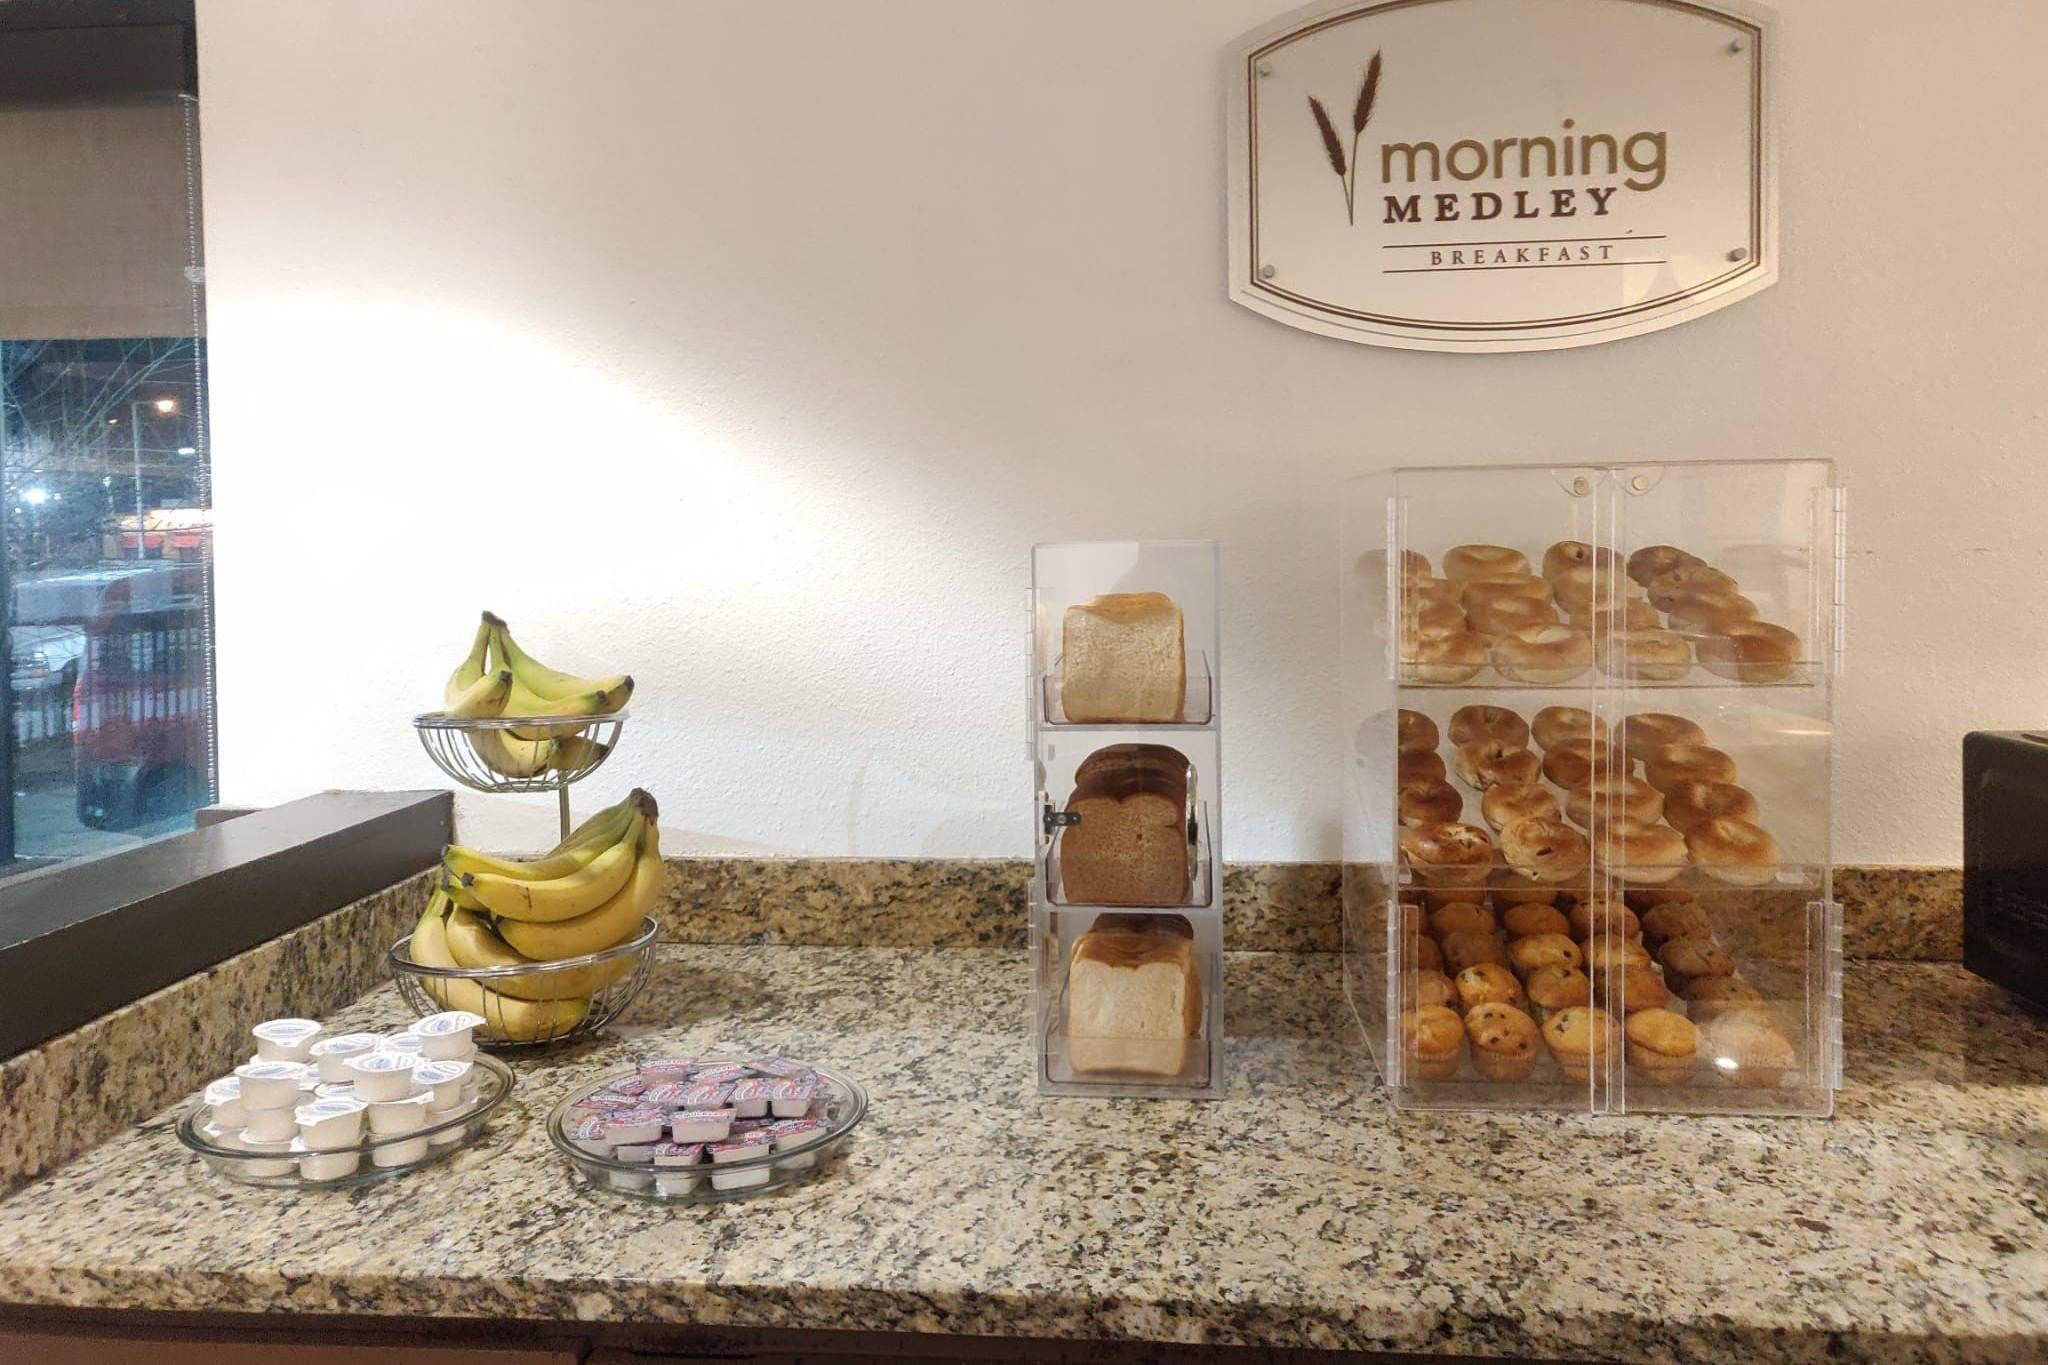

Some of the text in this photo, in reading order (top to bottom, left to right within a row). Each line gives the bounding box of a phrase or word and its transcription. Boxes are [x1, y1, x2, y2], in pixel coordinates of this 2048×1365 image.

[1382, 119, 1667, 191] morning
[1384, 187, 1617, 223] MEDLEY
[1431, 245, 1614, 265] BREAKFAST
